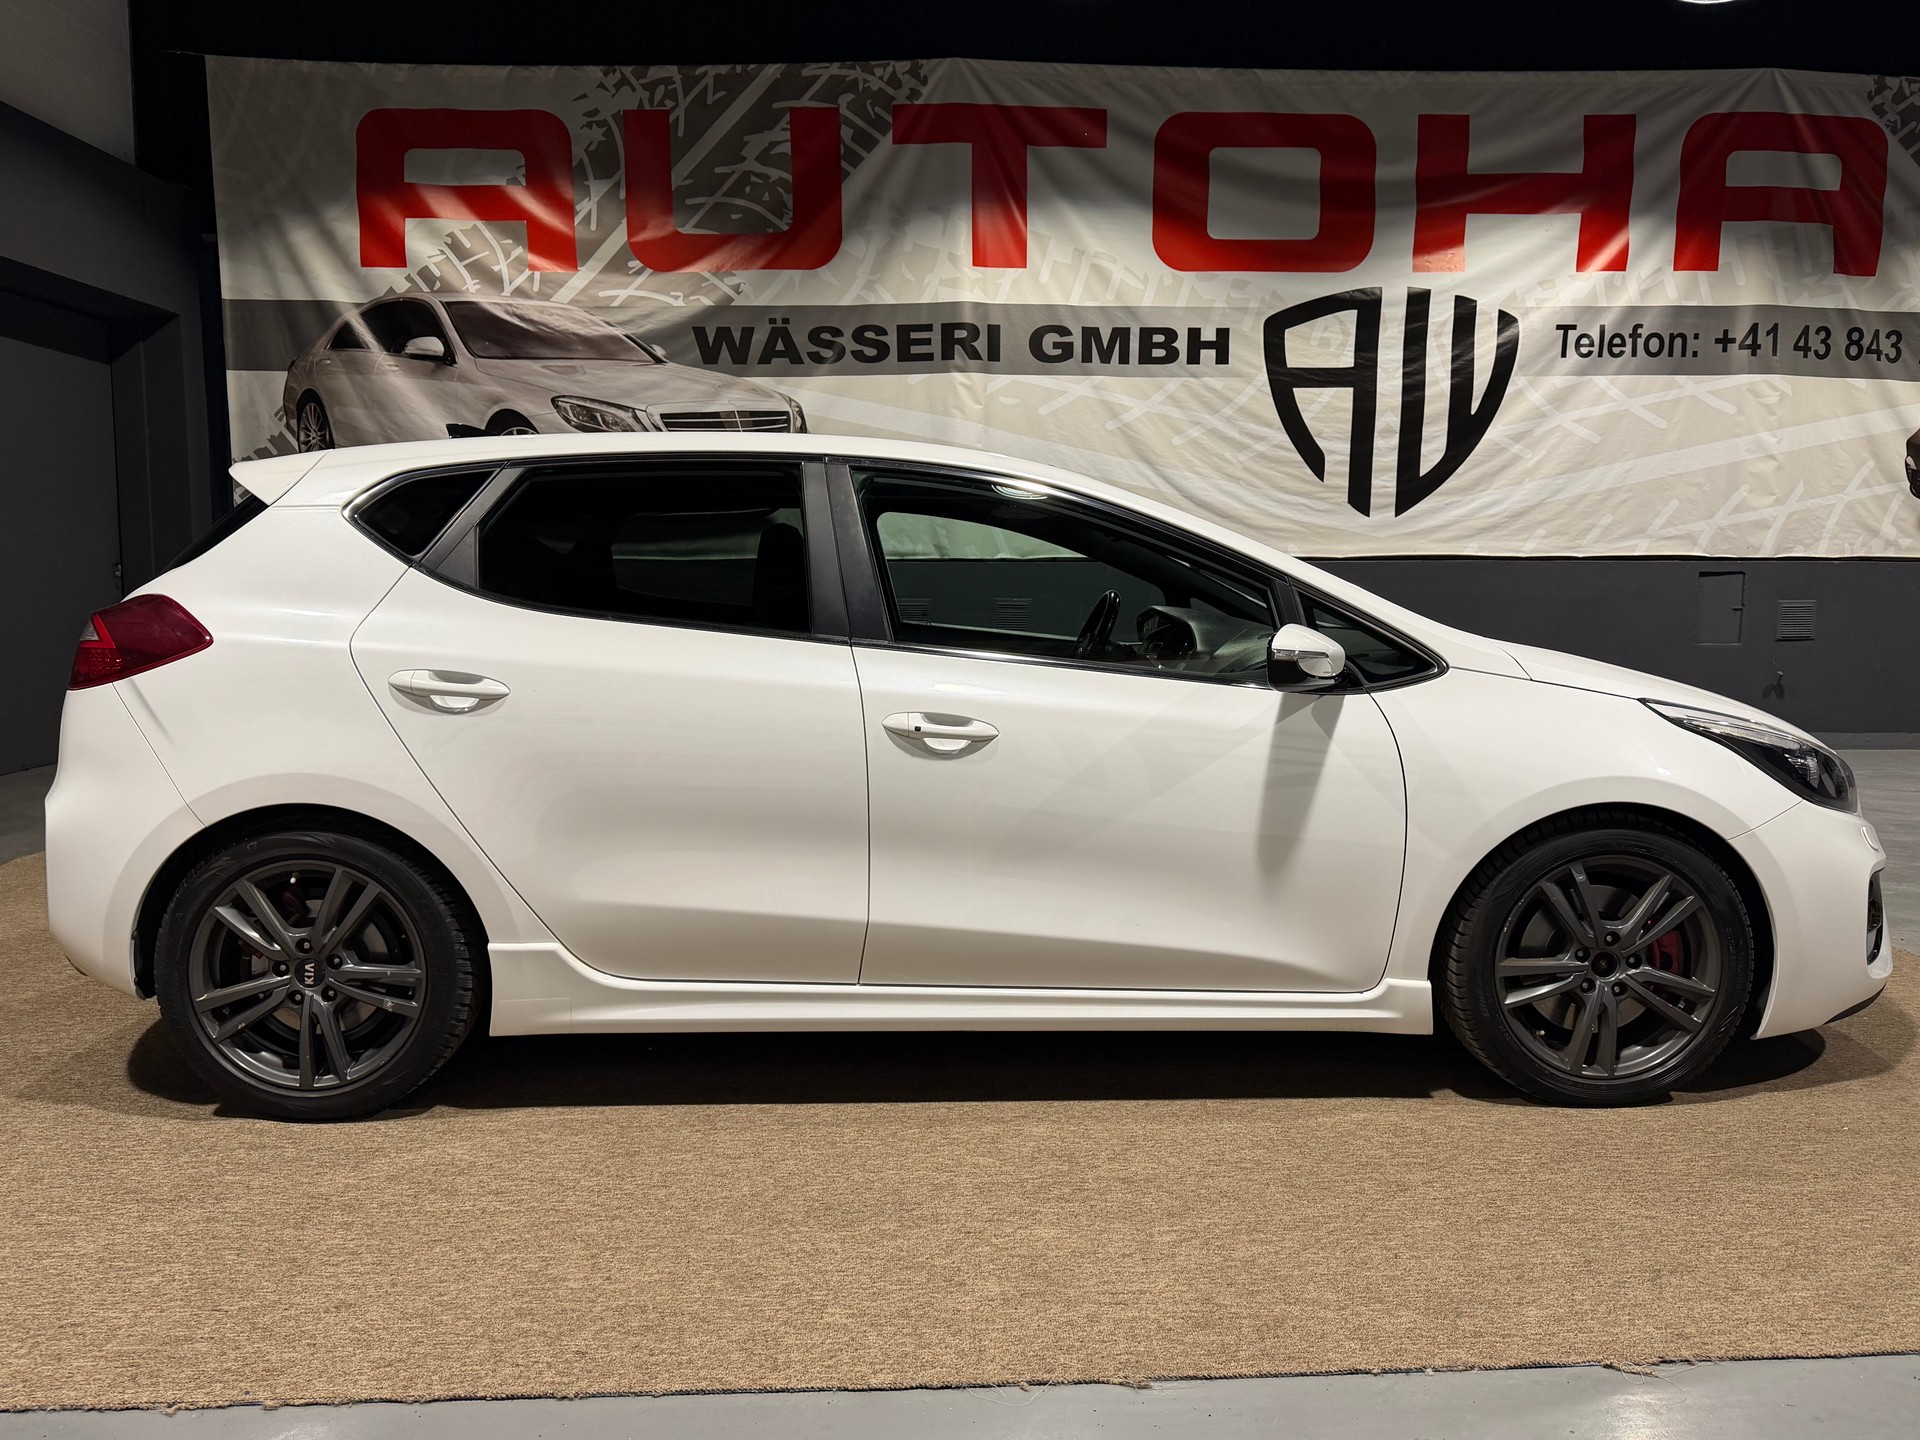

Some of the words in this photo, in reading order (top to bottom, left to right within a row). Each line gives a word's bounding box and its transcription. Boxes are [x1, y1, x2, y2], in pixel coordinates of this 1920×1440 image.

[357, 103, 1888, 277] AUTOHA
[691, 317, 1000, 365] WÄSSERI
[1028, 324, 1230, 365] GMBH
[1555, 323, 1700, 358] Telefon:
[1714, 322, 1779, 357] +41
[1793, 325, 1832, 360] 43
[1844, 326, 1903, 364] 843
[304, 962, 315, 985] KIA
